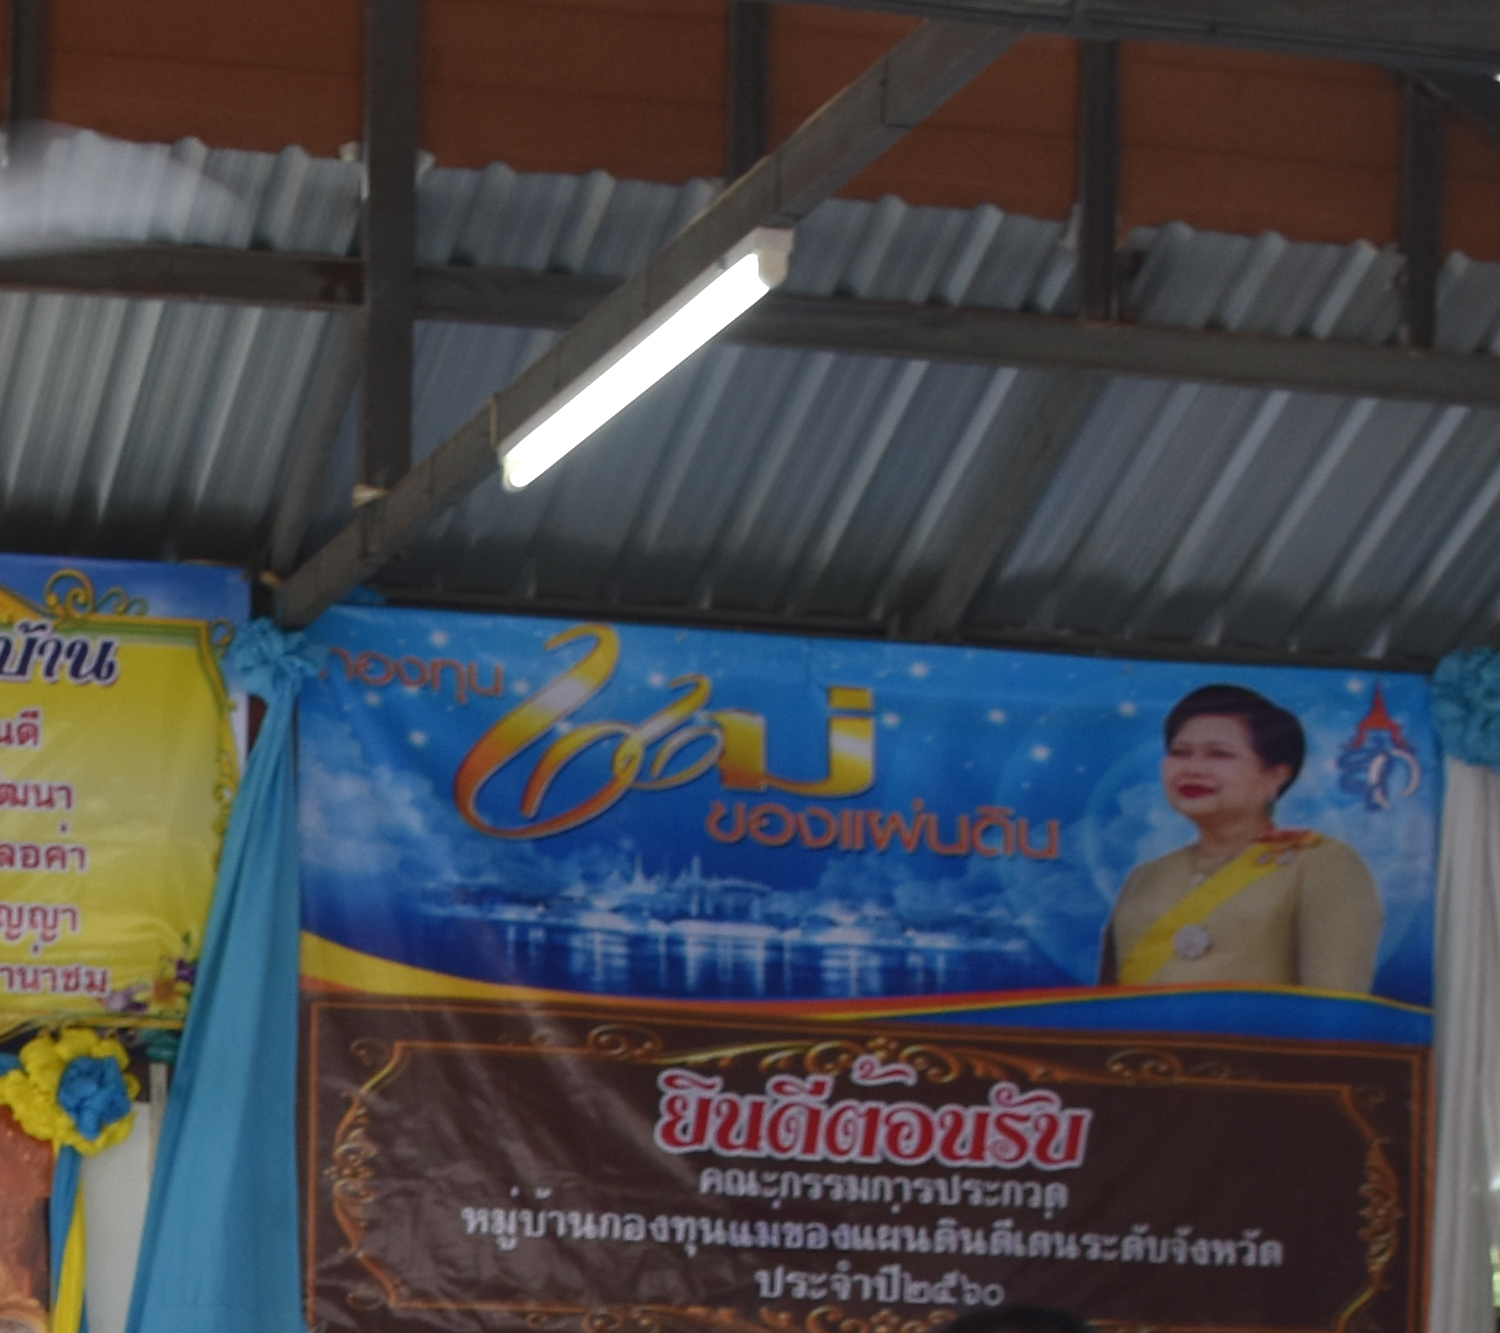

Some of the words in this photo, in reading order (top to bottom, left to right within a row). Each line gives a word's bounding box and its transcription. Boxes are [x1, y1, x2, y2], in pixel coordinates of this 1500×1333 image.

[706, 799, 1061, 861] ของแผ่นดิน
[653, 1057, 1093, 1171] ยินดีต้อนรับ
[699, 1165, 1069, 1209] คณะกรรมการประกวด
[460, 1187, 1284, 1268] หมู่บ้านกองทุนแม่ของแผ่นดินดีเด่นระดับจังหวัด
